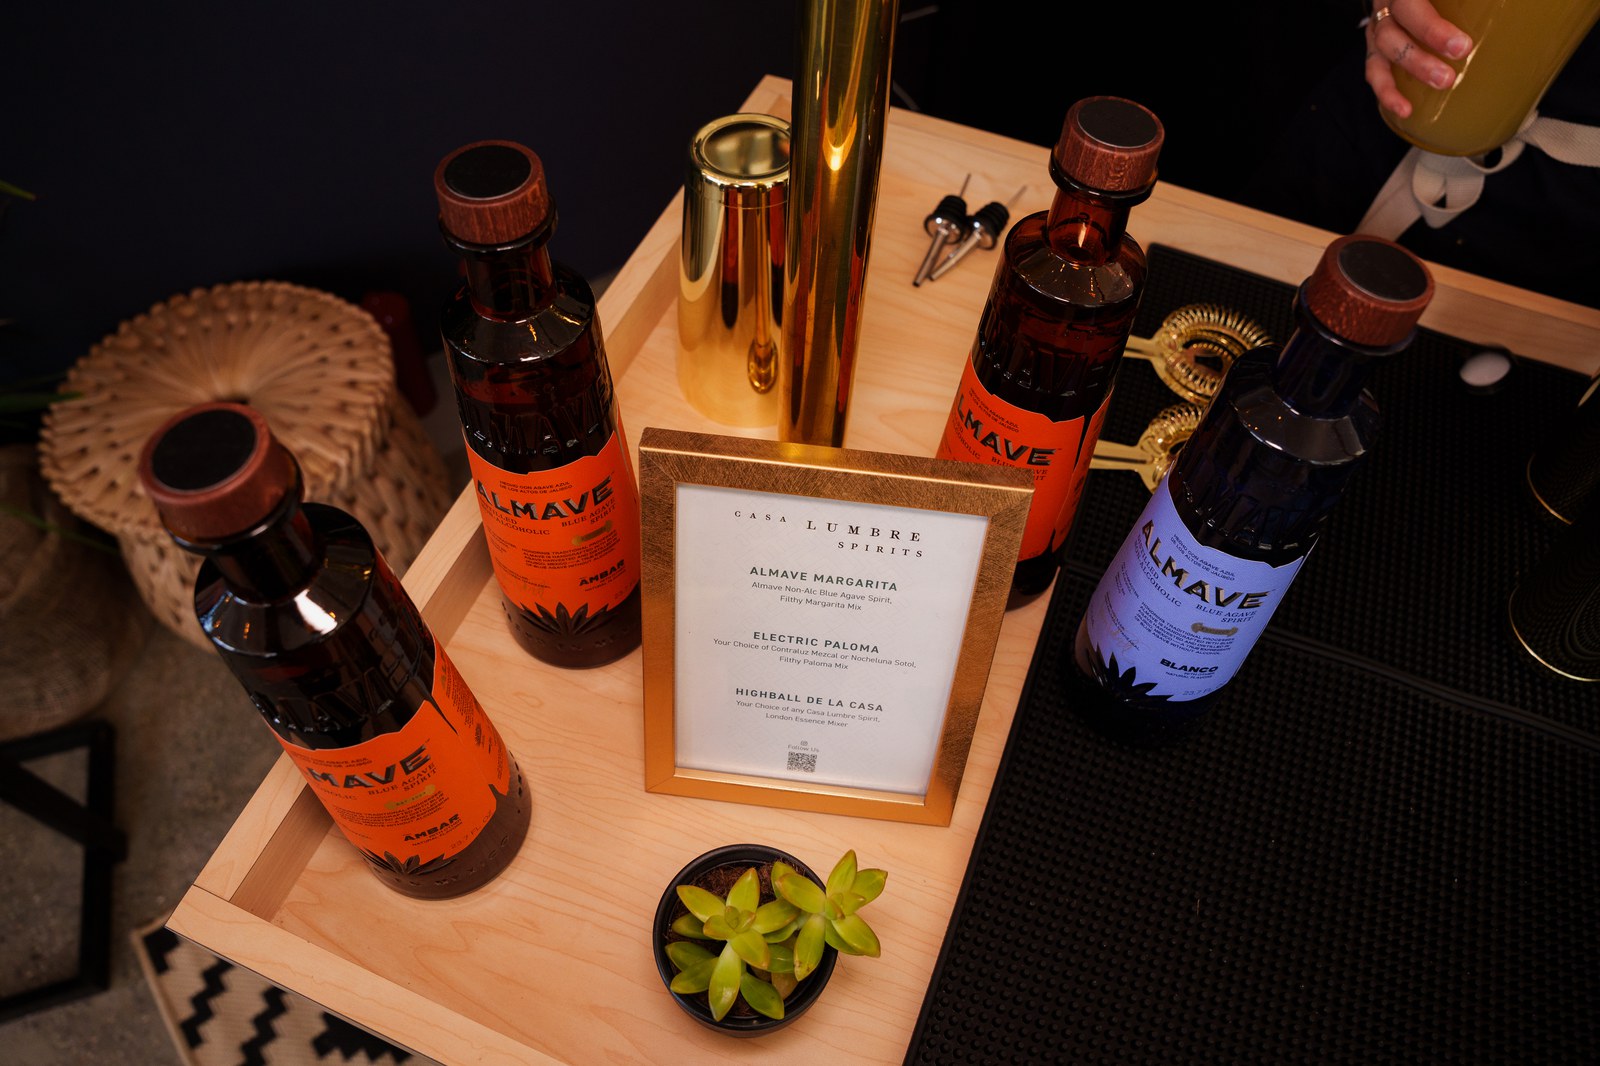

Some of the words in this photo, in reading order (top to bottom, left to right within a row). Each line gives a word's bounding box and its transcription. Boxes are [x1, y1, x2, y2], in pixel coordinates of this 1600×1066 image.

[957, 393, 1056, 466] LMAVE
[991, 456, 1016, 467] BLU
[477, 475, 614, 520] ALMAVE
[481, 502, 551, 535] ALCOHOLIC
[561, 516, 587, 527] BLUE
[589, 497, 615, 517] AGAVE
[590, 503, 616, 525] SPIRIT
[734, 510, 787, 523] CASA
[806, 520, 920, 542] LUMBRE
[837, 541, 922, 558] SPIRITS
[1174, 534, 1188, 550] HECHO
[1189, 549, 1200, 560] CON
[1199, 559, 1219, 572] AGAVE
[1219, 568, 1236, 576] AZUL
[1176, 543, 1185, 554] LOS
[1185, 552, 1202, 566] ALTOS
[1202, 564, 1210, 572] DE
[1134, 539, 1182, 607] NON-ALCOHOLIC
[1142, 521, 1270, 609] ALMAVE
[750, 566, 808, 581] ALMAVE
[814, 573, 897, 591] MARGARITA
[751, 581, 783, 591] Almave
[785, 585, 818, 595] Non-Alc
[820, 589, 838, 598] Blue
[840, 591, 866, 601] Agave
[868, 594, 892, 605] Spirit,
[780, 595, 803, 604] Filthy
[805, 598, 845, 609] Margarita
[1196, 604, 1223, 616] BLUE
[1224, 610, 1257, 618] AGAVE
[713, 638, 731, 646] Your
[733, 640, 760, 650] Choice
[771, 645, 809, 656] Contraluz
[811, 650, 838, 659] Mezcal
[851, 655, 892, 665] Nocheluna
[894, 659, 917, 668] Sotol,
[753, 631, 818, 646] ELECTRIC
[824, 640, 879, 654] PALOMA
[779, 656, 801, 665] Filthy
[803, 658, 832, 668] Paloma
[834, 662, 849, 670] Mix
[1160, 658, 1219, 673] BLANCO
[736, 688, 801, 703] HIGHBALL
[806, 696, 823, 705] DE
[828, 699, 844, 707] LA
[850, 701, 883, 712] CASA
[755, 702, 780, 711] Choice
[827, 711, 855, 720] Lumbre
[765, 713, 793, 721] London
[795, 716, 825, 725] Essence
[827, 720, 848, 728] Mixer
[305, 745, 431, 789] MAVE
[368, 784, 398, 795] BLUE
[401, 762, 435, 787] AGAVE
[403, 768, 437, 792] SPIRIT
